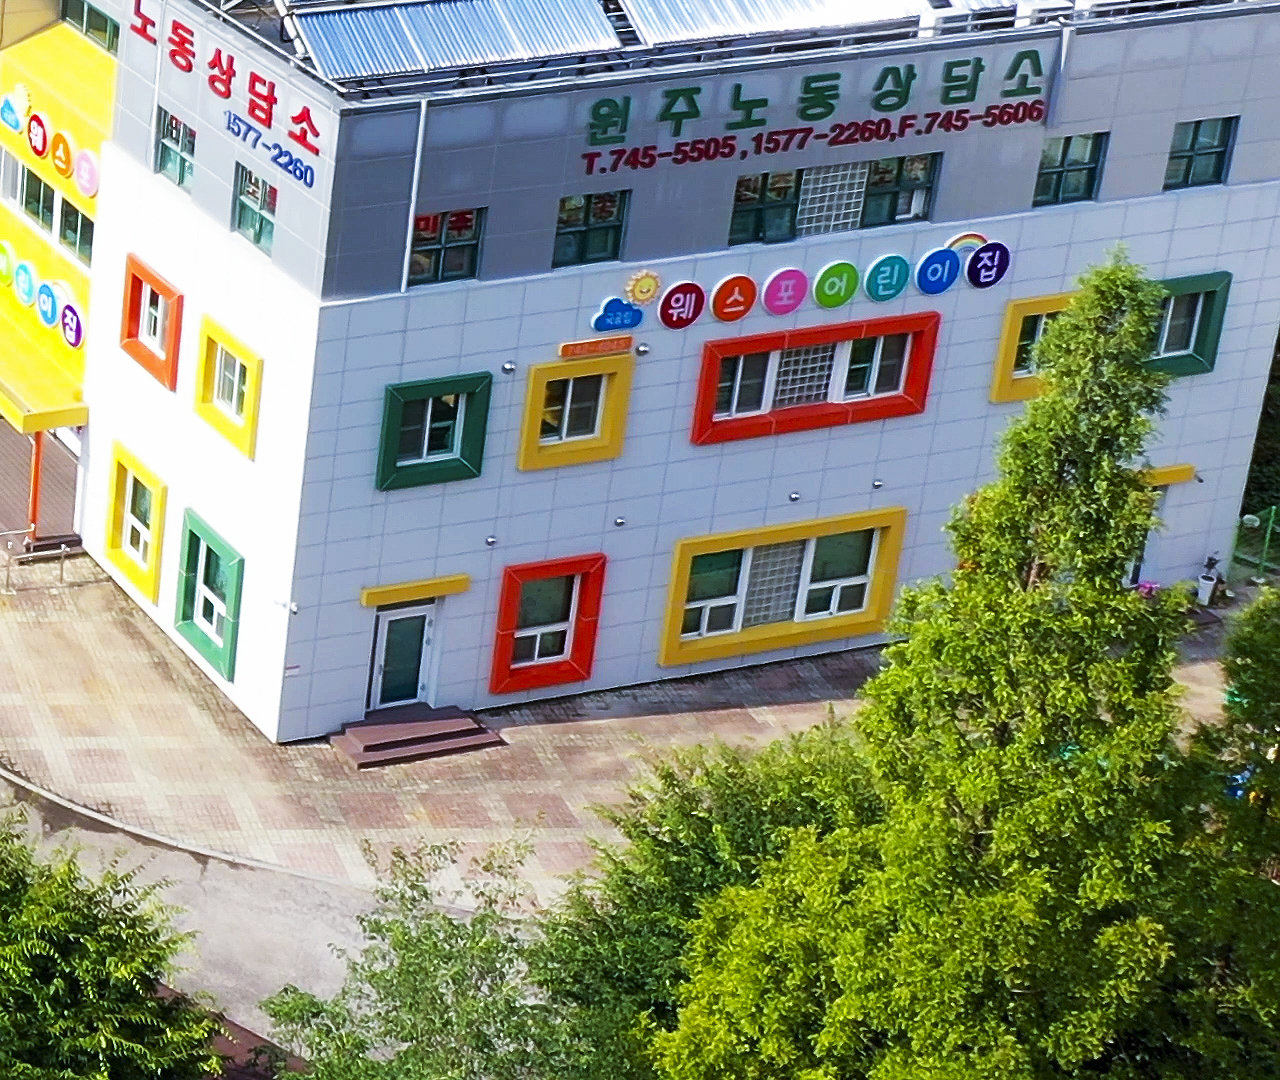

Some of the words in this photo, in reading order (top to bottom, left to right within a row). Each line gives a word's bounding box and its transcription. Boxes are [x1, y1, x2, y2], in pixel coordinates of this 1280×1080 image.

[586, 49, 1044, 147] 원주노동상담소
[224, 109, 315, 189] 1577-2260
[667, 250, 1000, 322] 웨스포어린이집
